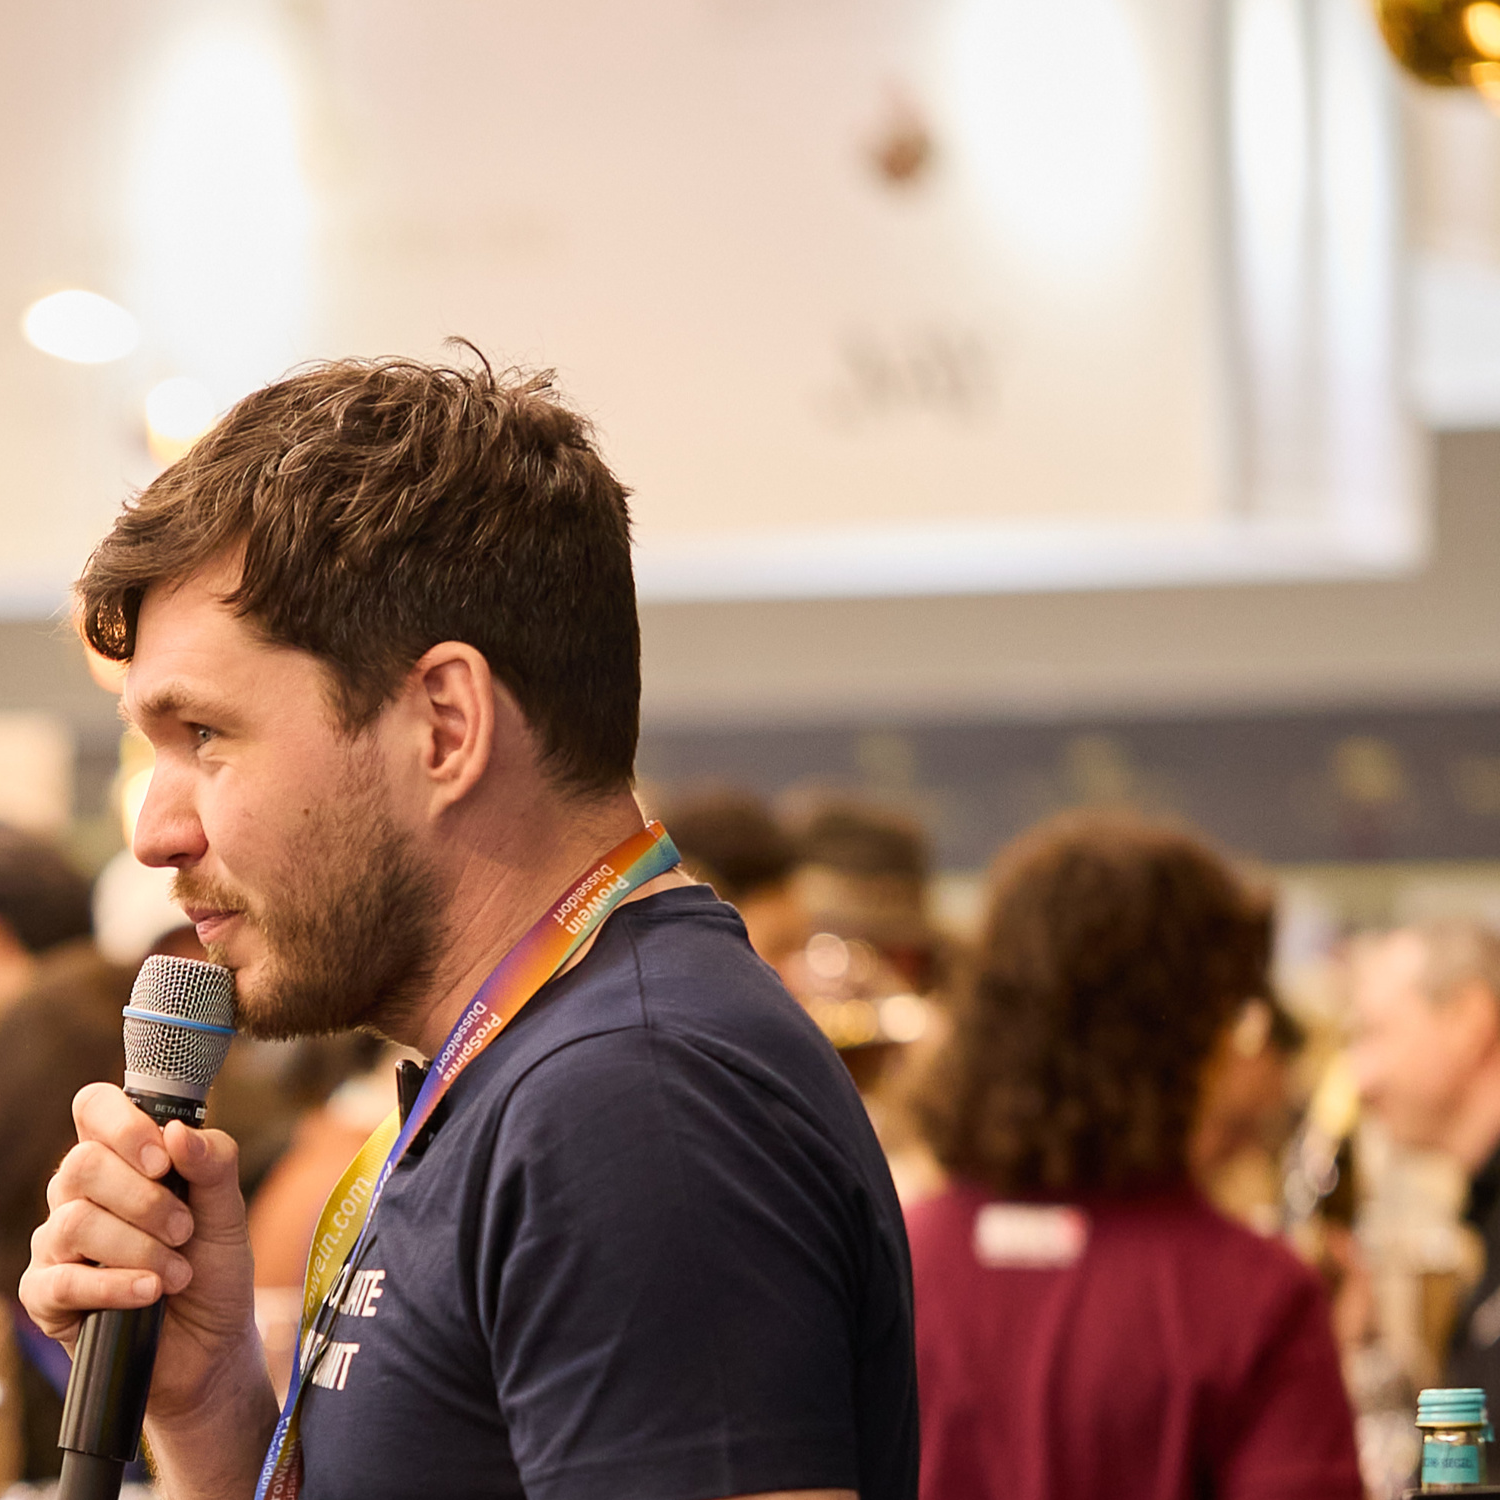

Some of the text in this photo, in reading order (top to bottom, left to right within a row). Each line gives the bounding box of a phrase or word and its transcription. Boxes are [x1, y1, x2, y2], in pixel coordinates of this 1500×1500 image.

[552, 864, 615, 926] Düsseldorf
[565, 874, 630, 935] ProWein
[435, 1001, 488, 1075] Düsseldorf
[442, 1012, 503, 1082] ProSpirits
[155, 1103, 176, 1115] BETA
